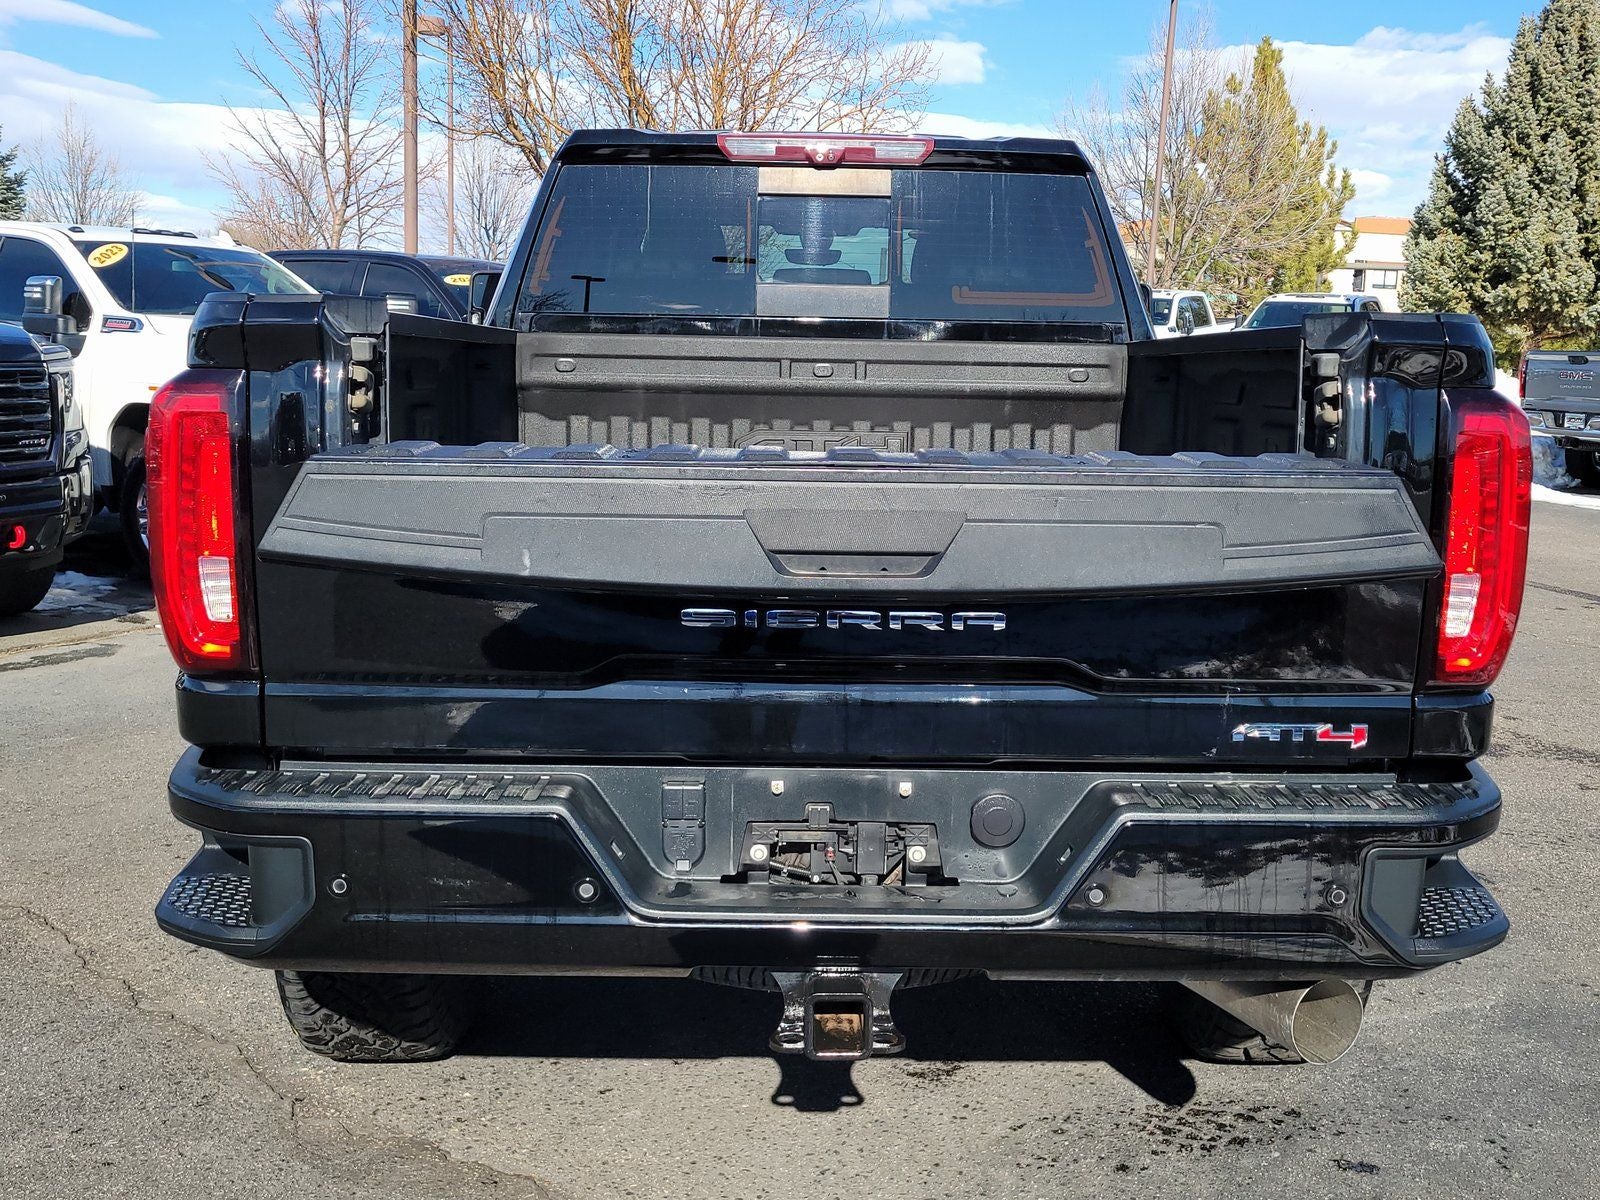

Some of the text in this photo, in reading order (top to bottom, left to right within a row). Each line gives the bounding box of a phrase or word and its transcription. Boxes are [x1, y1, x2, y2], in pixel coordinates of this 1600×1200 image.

[93, 245, 124, 265] 2023
[1559, 370, 1593, 381] GMC
[680, 607, 1007, 632] SIERRA
[1231, 723, 1369, 749] AT4
